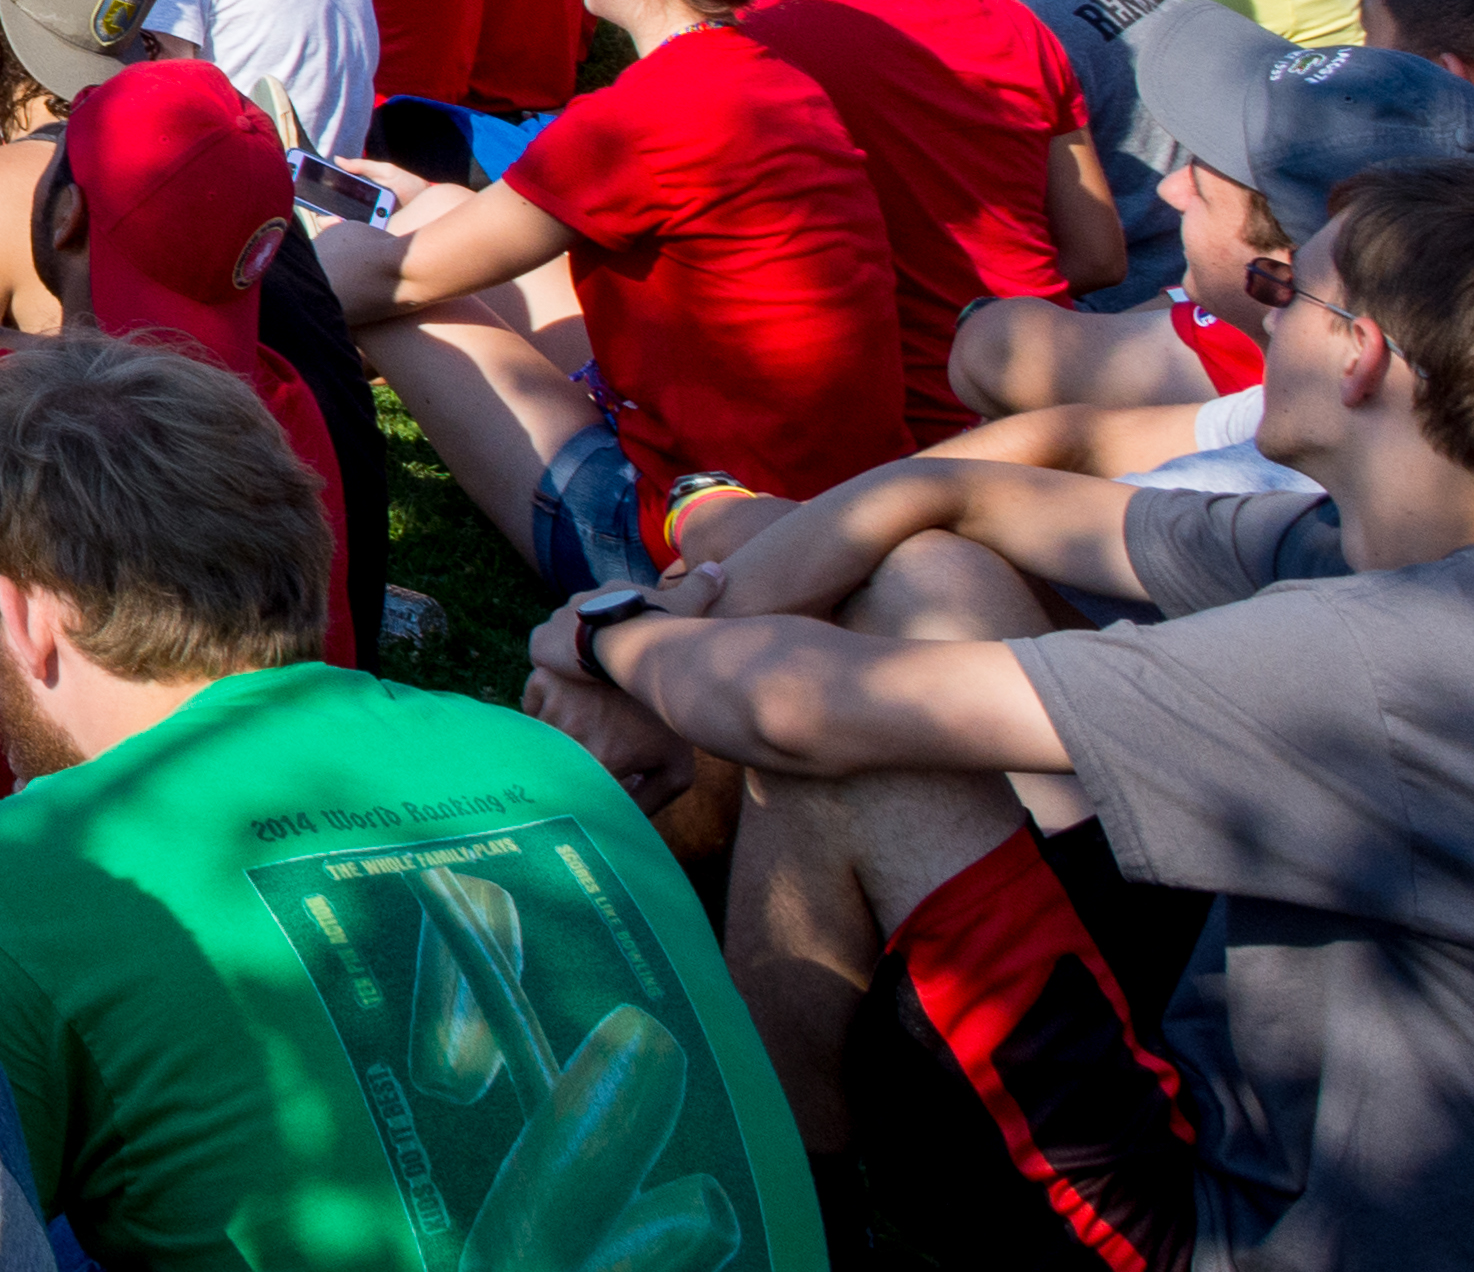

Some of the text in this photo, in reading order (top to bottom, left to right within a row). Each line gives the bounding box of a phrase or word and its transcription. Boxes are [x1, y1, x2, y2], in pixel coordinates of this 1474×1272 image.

[251, 783, 536, 843] 2014 World Ranking #2
[326, 861, 360, 881] THE
[360, 851, 416, 876] WHOLE
[415, 845, 472, 869] FAMILY
[555, 844, 602, 894] SCORES
[594, 896, 622, 927] LIKE
